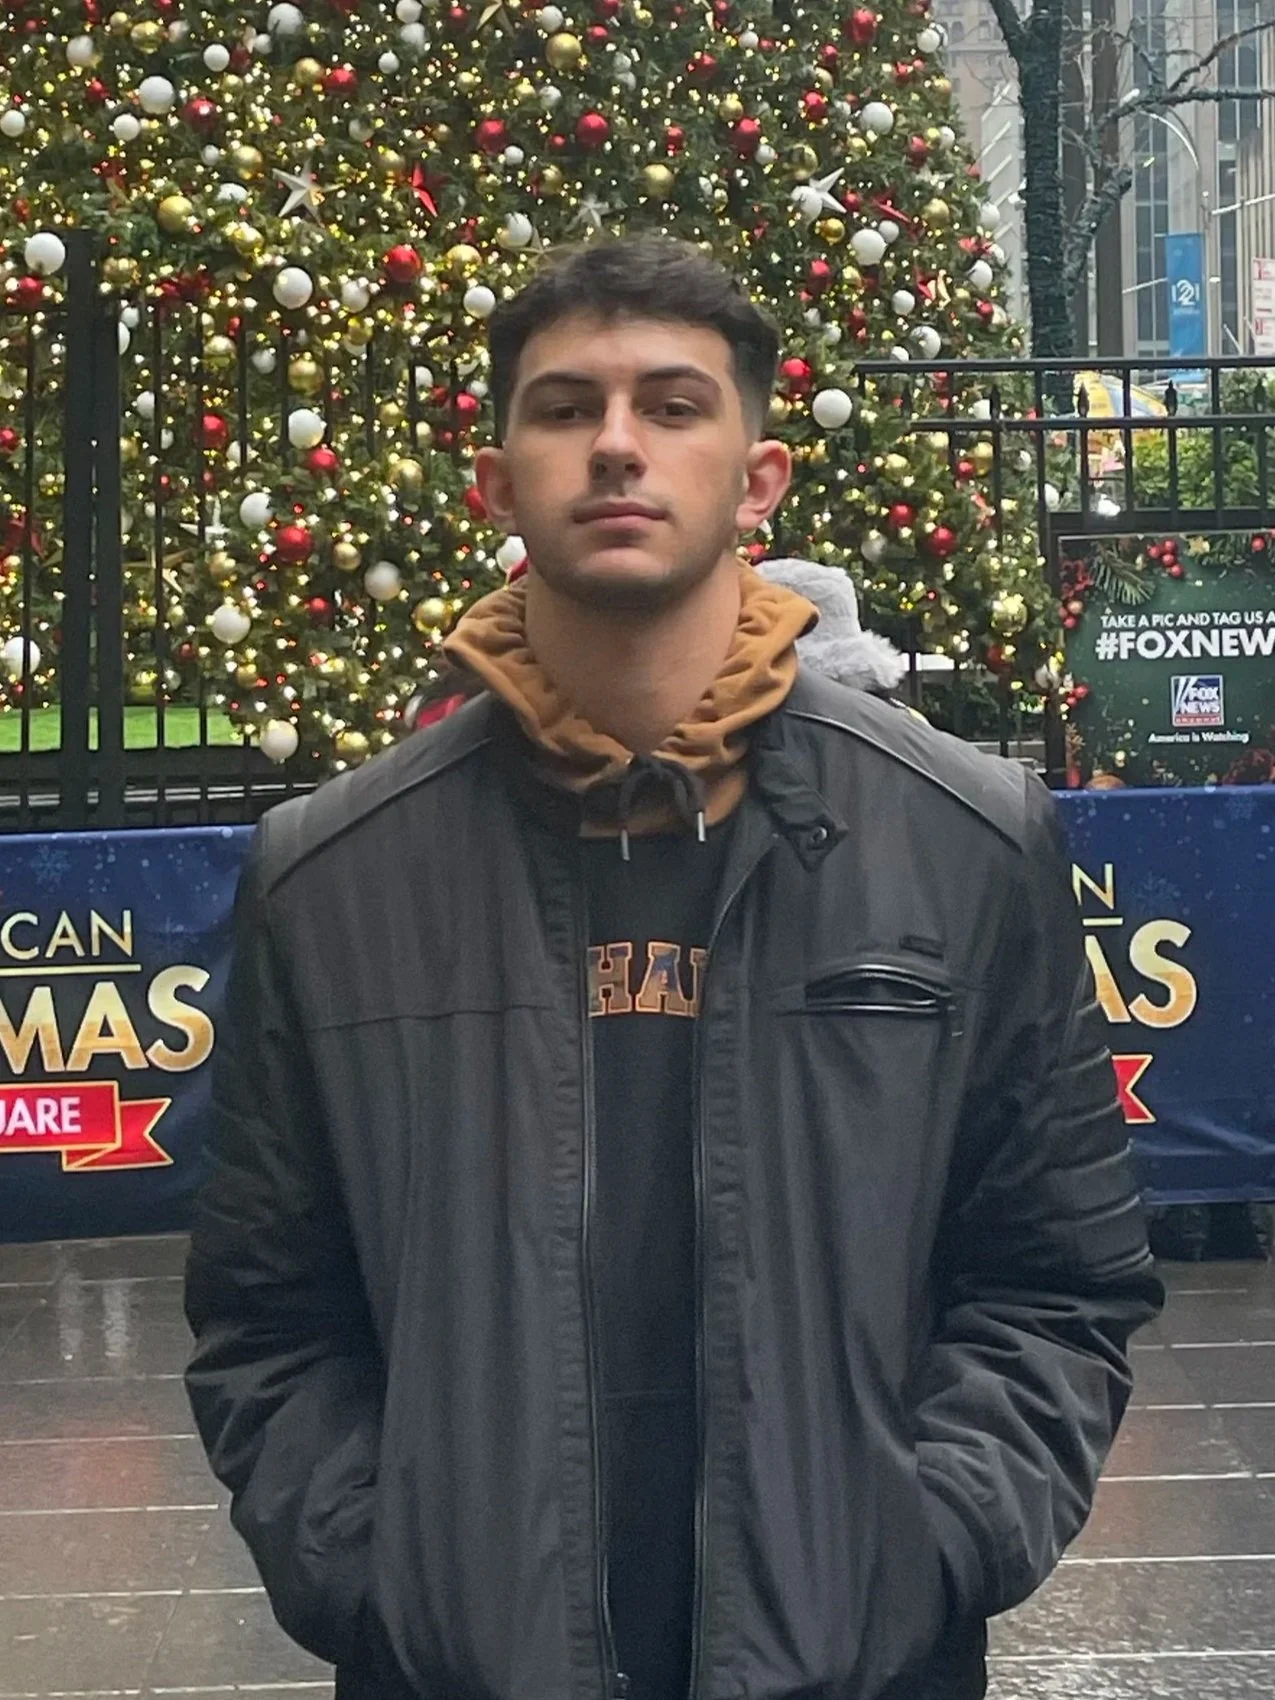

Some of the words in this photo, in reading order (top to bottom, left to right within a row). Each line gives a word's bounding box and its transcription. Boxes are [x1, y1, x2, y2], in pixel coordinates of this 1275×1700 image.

[1101, 614, 1135, 628] TAKE
[1138, 614, 1149, 627] A
[1152, 613, 1174, 627] PIC
[1176, 612, 1210, 626] AND
[1212, 612, 1241, 625] TAG
[1244, 611, 1263, 624] US
[1188, 687, 1219, 700] FOX
[1181, 700, 1220, 713] NEWS
[1148, 732, 1190, 743] America
[1201, 731, 1250, 743] Watching
[0, 910, 133, 960] CAN
[587, 942, 707, 1018] HA
[0, 1097, 81, 1136] ARE
